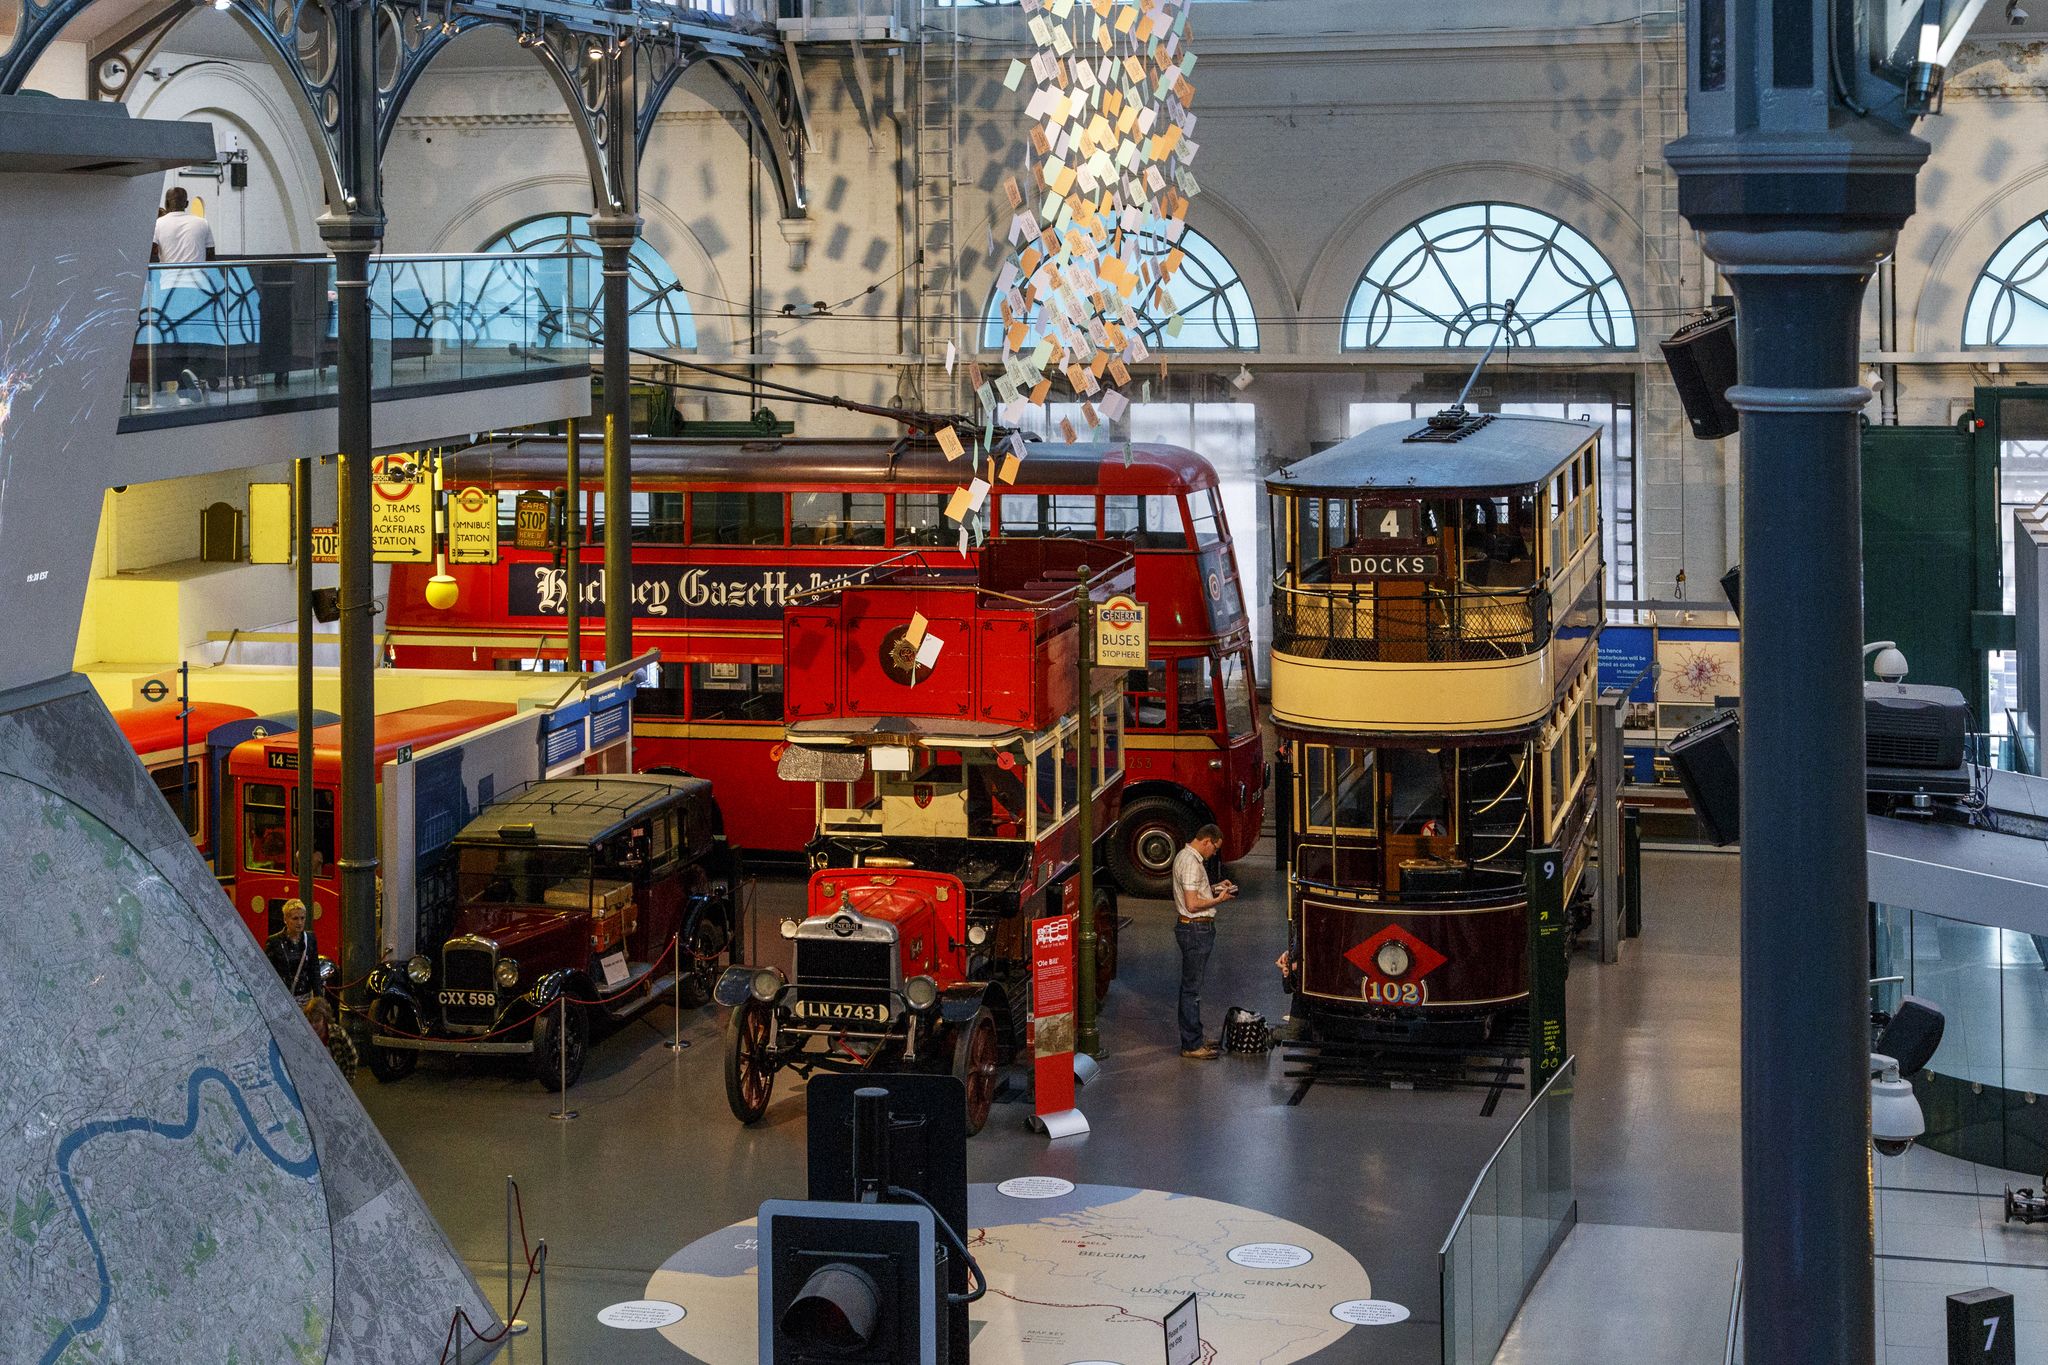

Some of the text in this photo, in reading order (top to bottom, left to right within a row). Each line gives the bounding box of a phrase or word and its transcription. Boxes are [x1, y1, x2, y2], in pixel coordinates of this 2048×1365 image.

[372, 504, 420, 513] O TRAMS
[453, 521, 490, 529] OMNIBUS
[520, 512, 545, 529] STOP
[1380, 510, 1399, 537] 4
[373, 525, 425, 534] ACKFRIARS
[372, 537, 416, 545] STATION
[457, 534, 489, 542] STATION
[1350, 558, 1424, 573] DOCKS
[678, 568, 803, 607] Gazette
[1101, 610, 1141, 621] GENERAL
[1102, 634, 1140, 646] BUSES
[271, 754, 284, 766] 14
[1129, 757, 1151, 769] 253
[1543, 861, 1555, 879] 9
[826, 922, 862, 931] GENERAL
[439, 992, 496, 1006] CXX 598
[1369, 981, 1420, 1005] 102
[809, 1003, 874, 1019] LN 4743
[1078, 1250, 1146, 1260] BELGIUM
[1243, 1279, 1328, 1290] GERMANY
[1984, 1316, 2000, 1351] 7
